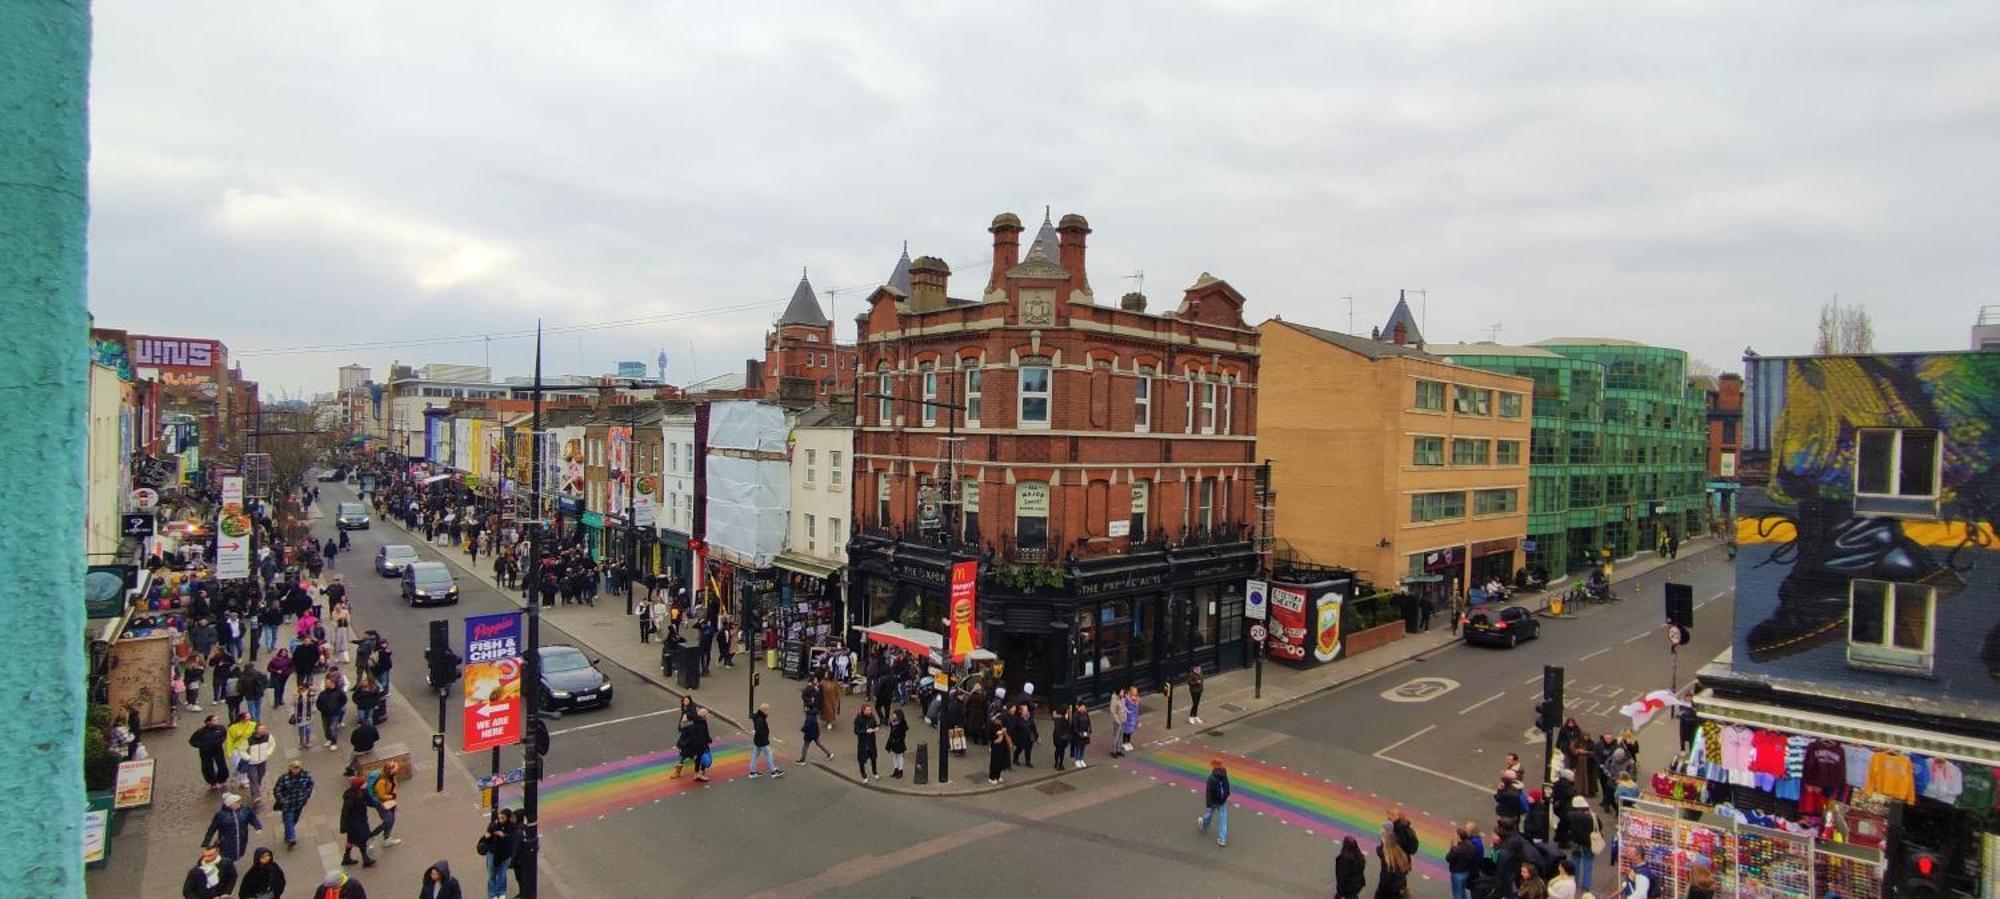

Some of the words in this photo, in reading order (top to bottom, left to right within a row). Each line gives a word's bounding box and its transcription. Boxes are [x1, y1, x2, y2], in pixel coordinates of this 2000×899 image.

[1081, 583, 1099, 594] THE
[1253, 629, 1265, 637] 20
[470, 639, 502, 652] FISH
[505, 638, 516, 647] &
[470, 647, 516, 661] CHIPS
[476, 719, 491, 730] WE
[492, 716, 510, 728] ARE
[481, 727, 504, 739] HERE
